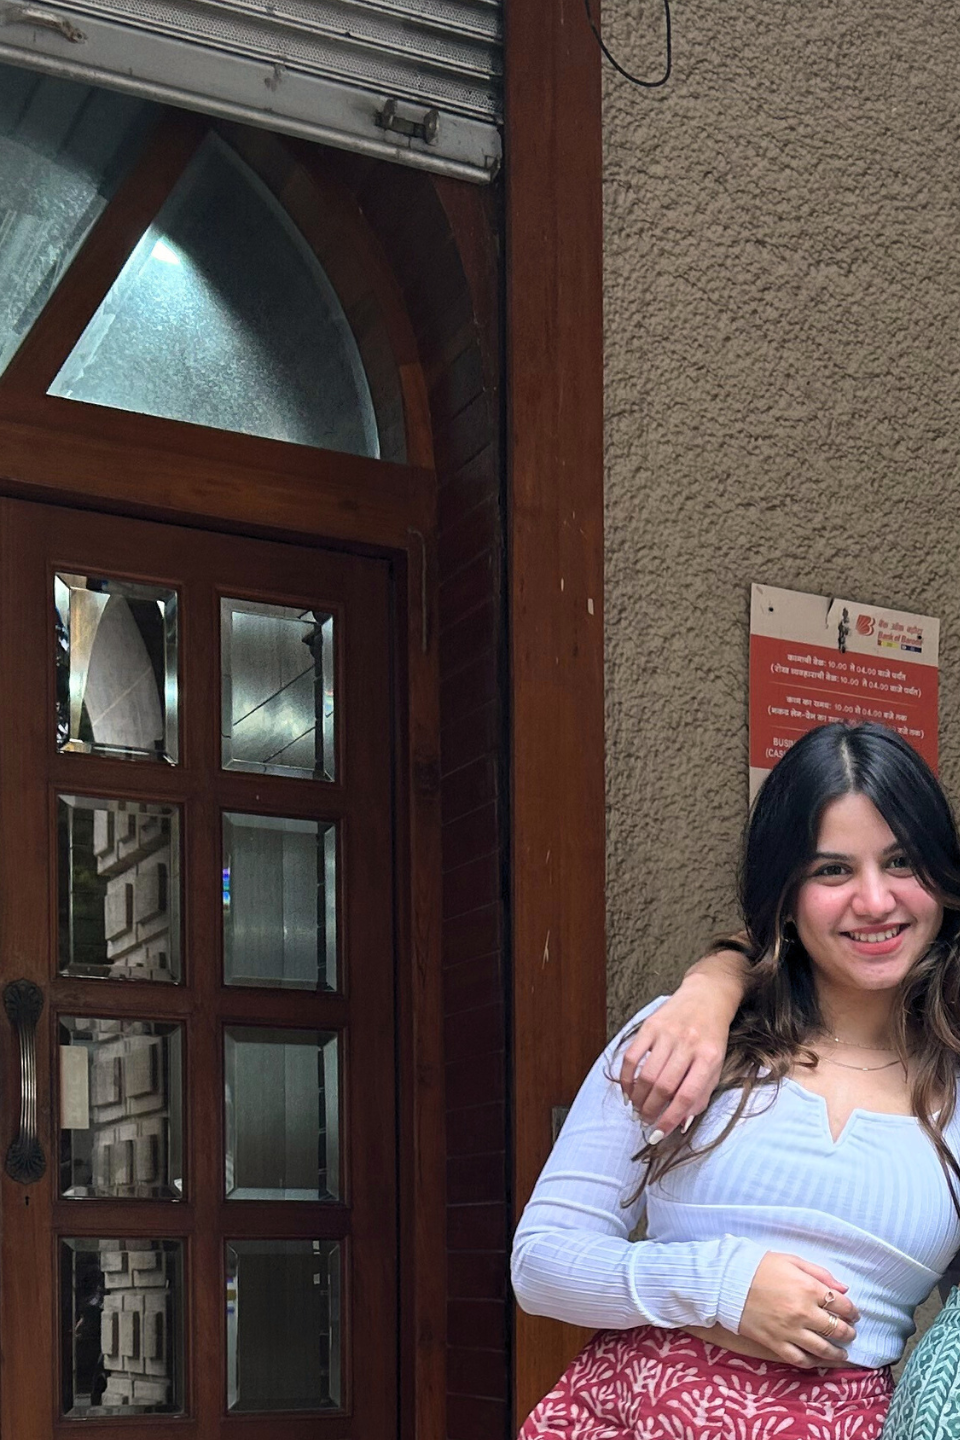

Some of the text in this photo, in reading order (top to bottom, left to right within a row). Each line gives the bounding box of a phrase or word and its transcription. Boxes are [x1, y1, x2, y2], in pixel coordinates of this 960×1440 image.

[828, 661, 847, 670] 10.00
[856, 667, 876, 676] 04.00
[841, 676, 859, 686] 10.00
[869, 681, 889, 691] 04.00
[834, 703, 853, 713] 10.00
[862, 708, 882, 718] 04.00
[765, 748, 786, 759] (CAS
